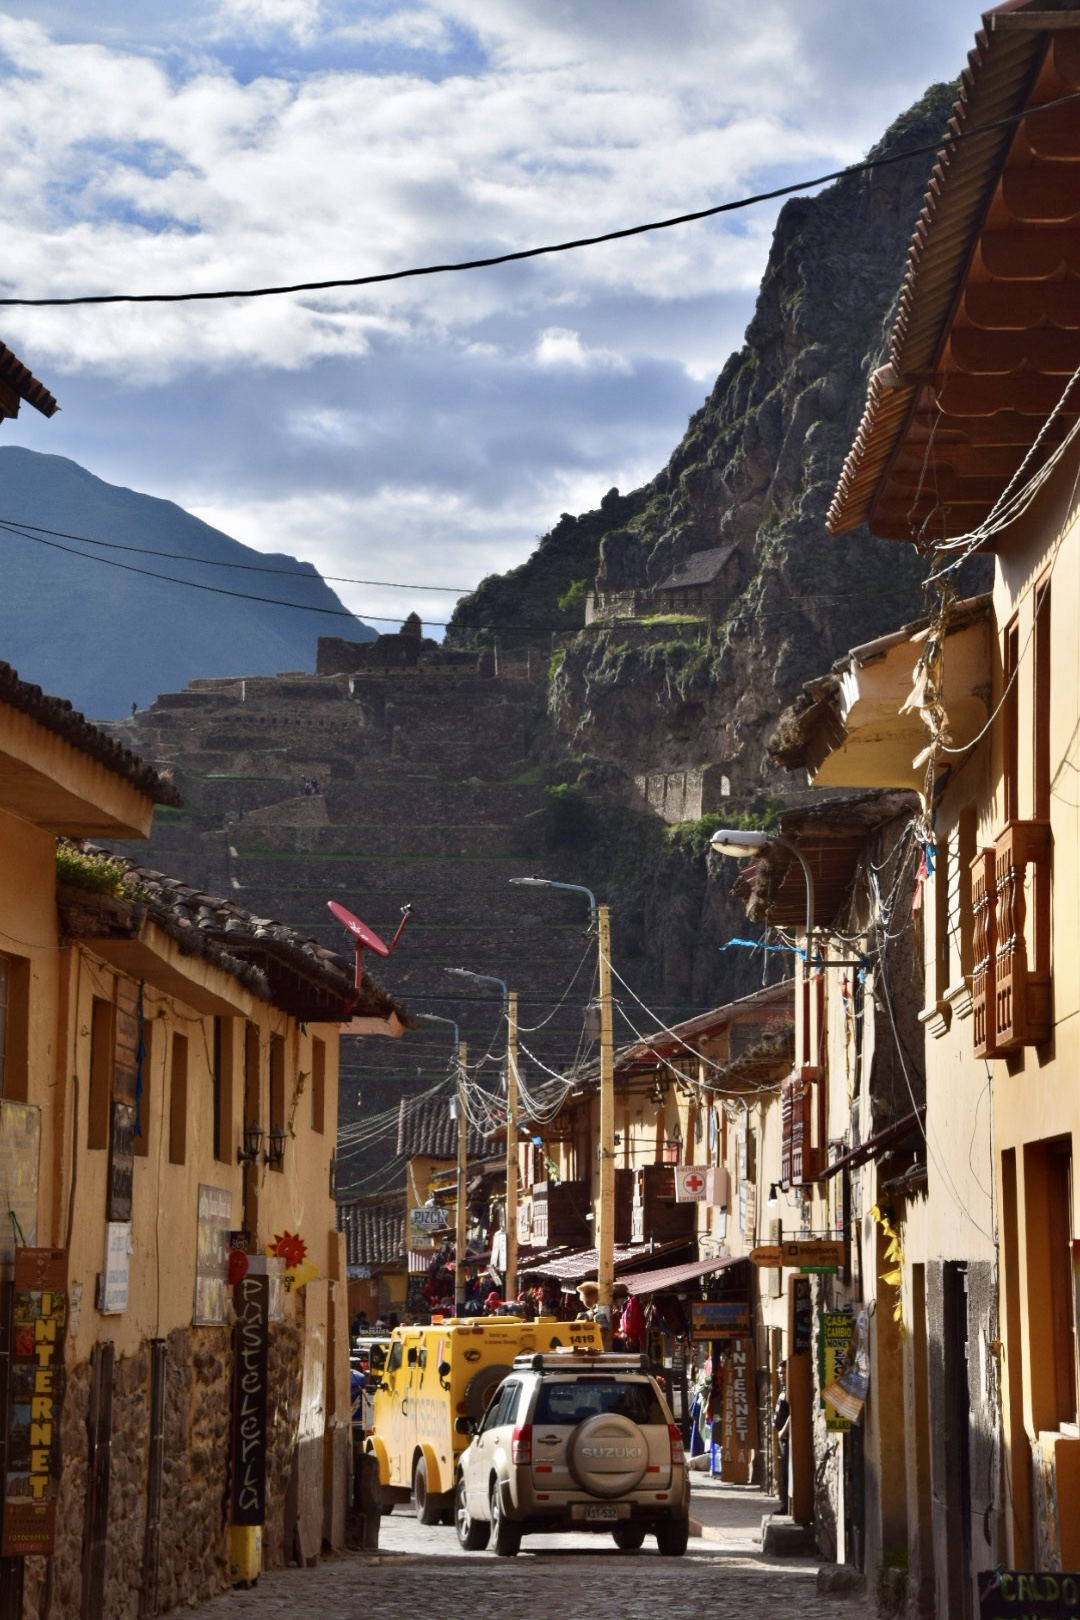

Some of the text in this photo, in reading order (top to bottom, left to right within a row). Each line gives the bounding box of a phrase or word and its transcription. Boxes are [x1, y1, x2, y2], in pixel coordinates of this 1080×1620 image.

[693, 1304, 747, 1315] LAUNDRY
[827, 1327, 852, 1338] CAMBIO
[569, 1335, 595, 1344] 1419
[827, 1340, 850, 1348] MONEY
[31, 1293, 56, 1499] INTERNET
[733, 1340, 749, 1441] INTERNET
[581, 1447, 642, 1459] SUZUKI
[1001, 1572, 1079, 1606] CALDO
